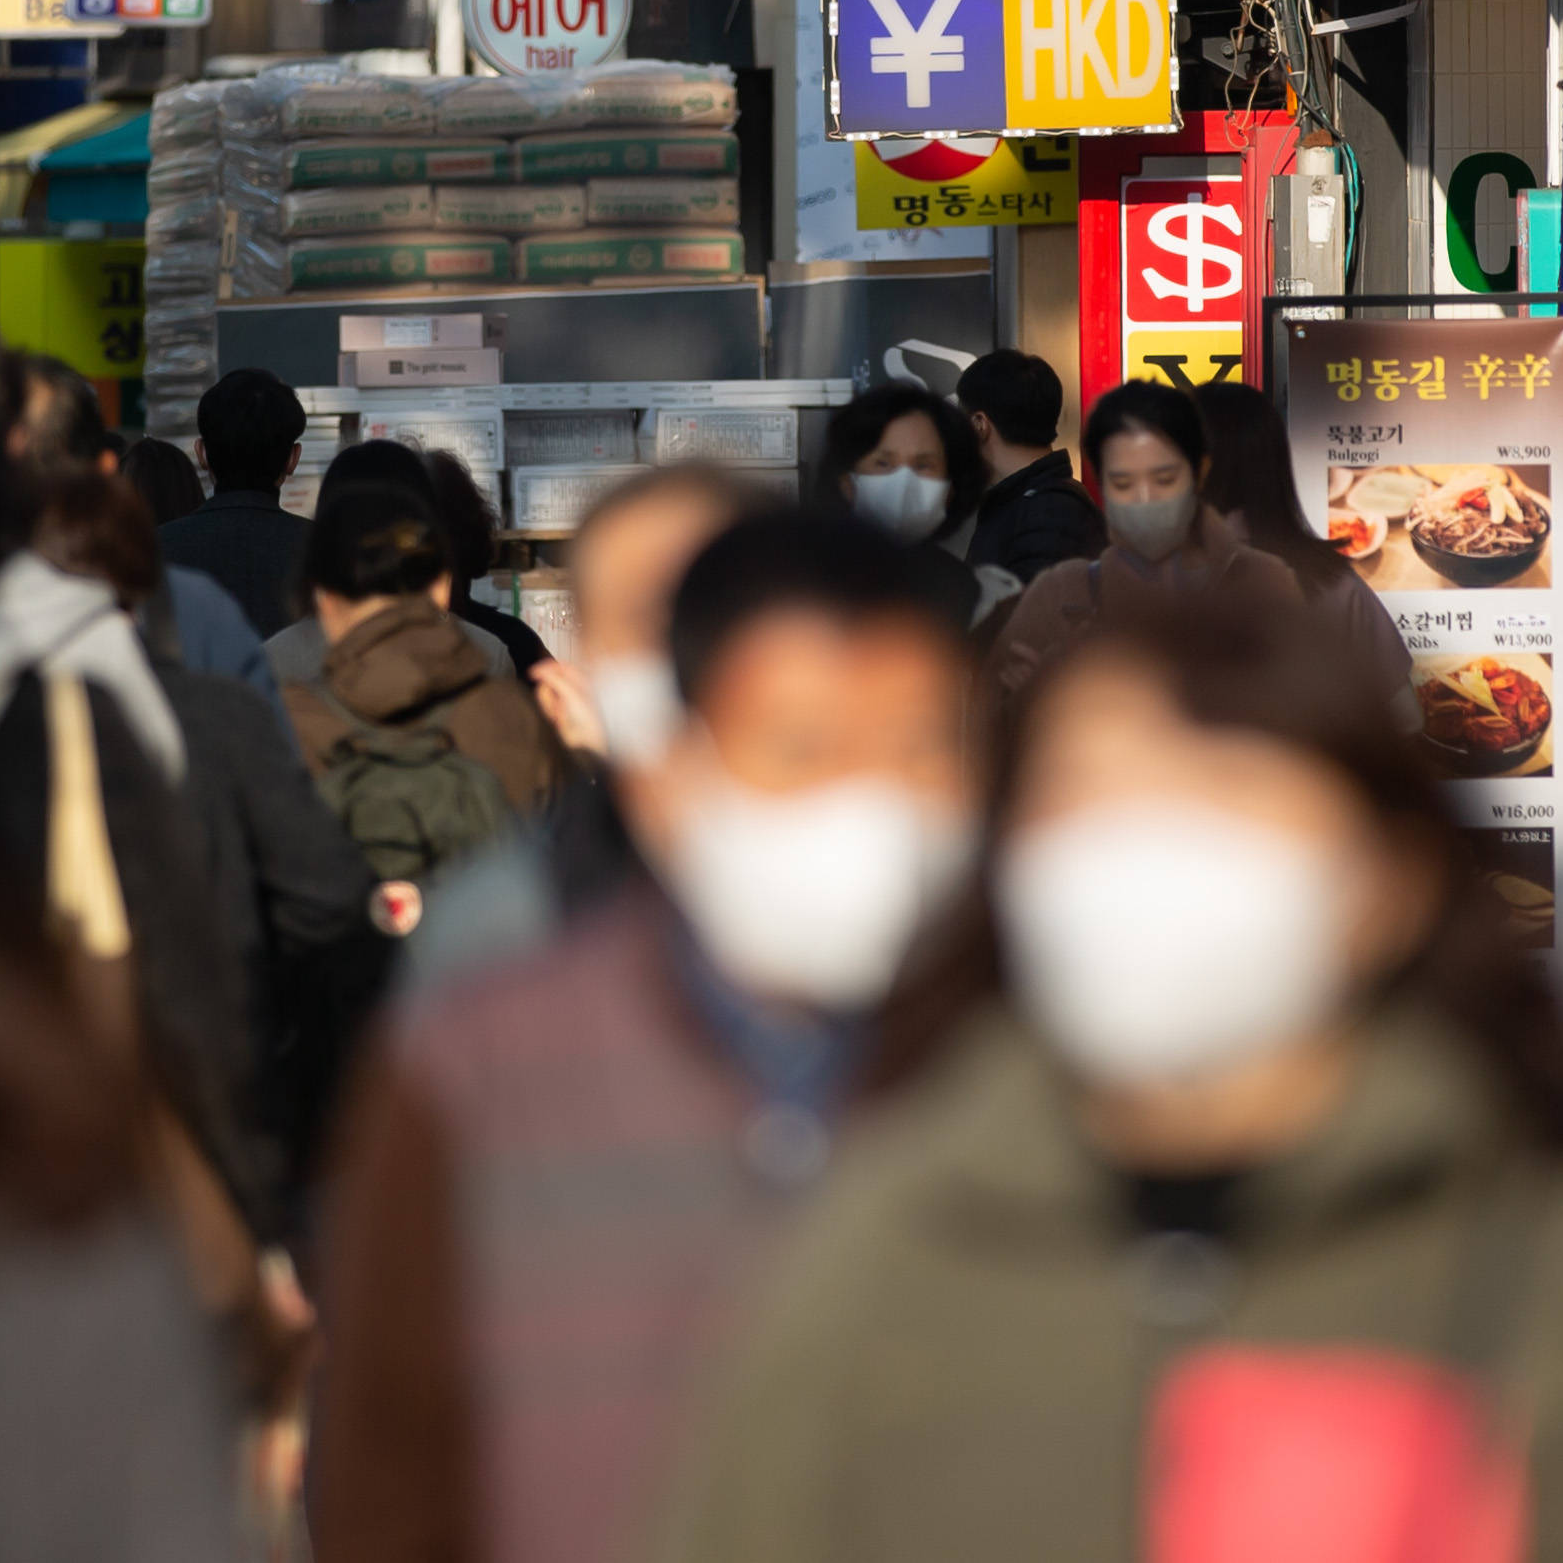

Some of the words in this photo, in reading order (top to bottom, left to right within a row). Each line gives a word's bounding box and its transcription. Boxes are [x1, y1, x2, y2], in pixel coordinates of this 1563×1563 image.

[525, 46, 577, 71] hair
[1142, 192, 1243, 313] $
[1326, 355, 1447, 402] 명동길
[1462, 353, 1553, 400] 辛辛
[1327, 447, 1380, 464] Bulgogi
[1408, 635, 1439, 650] Ribs
